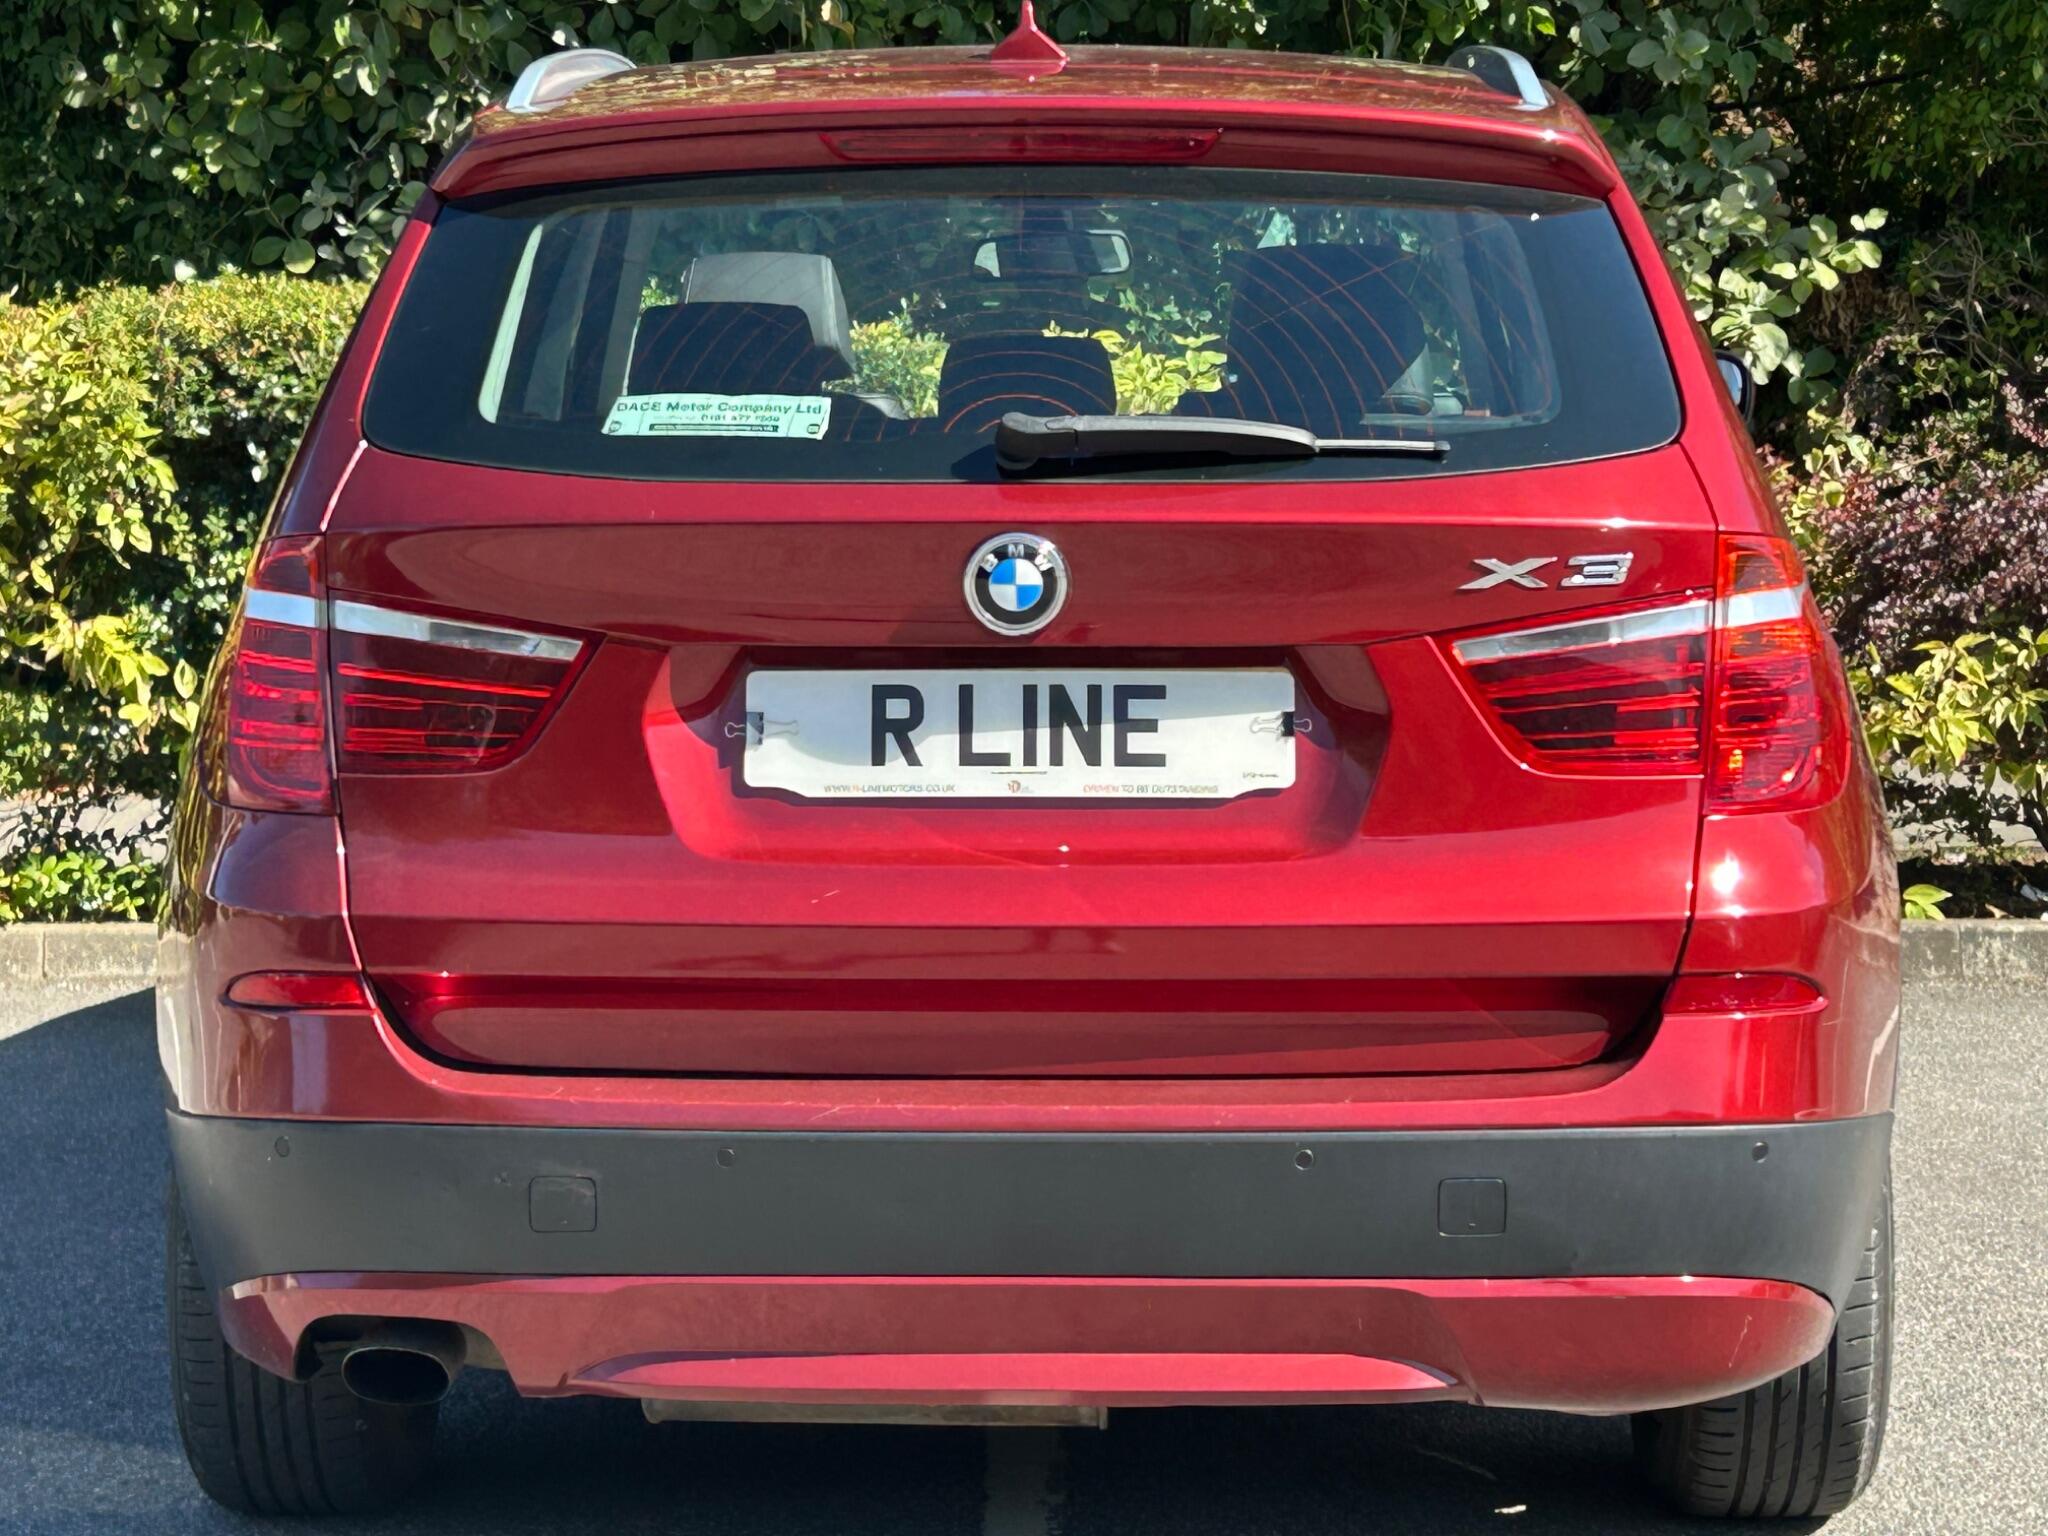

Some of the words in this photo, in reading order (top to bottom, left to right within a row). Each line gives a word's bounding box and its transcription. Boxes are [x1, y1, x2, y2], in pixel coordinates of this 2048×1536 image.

[617, 402, 661, 412] DACE
[666, 402, 712, 412] Motor
[717, 403, 792, 414] Company
[796, 403, 822, 414] Ltd
[980, 543, 1053, 573] BMW
[1458, 552, 1635, 589] X3
[871, 684, 924, 767] R
[958, 684, 1167, 767] LINE
